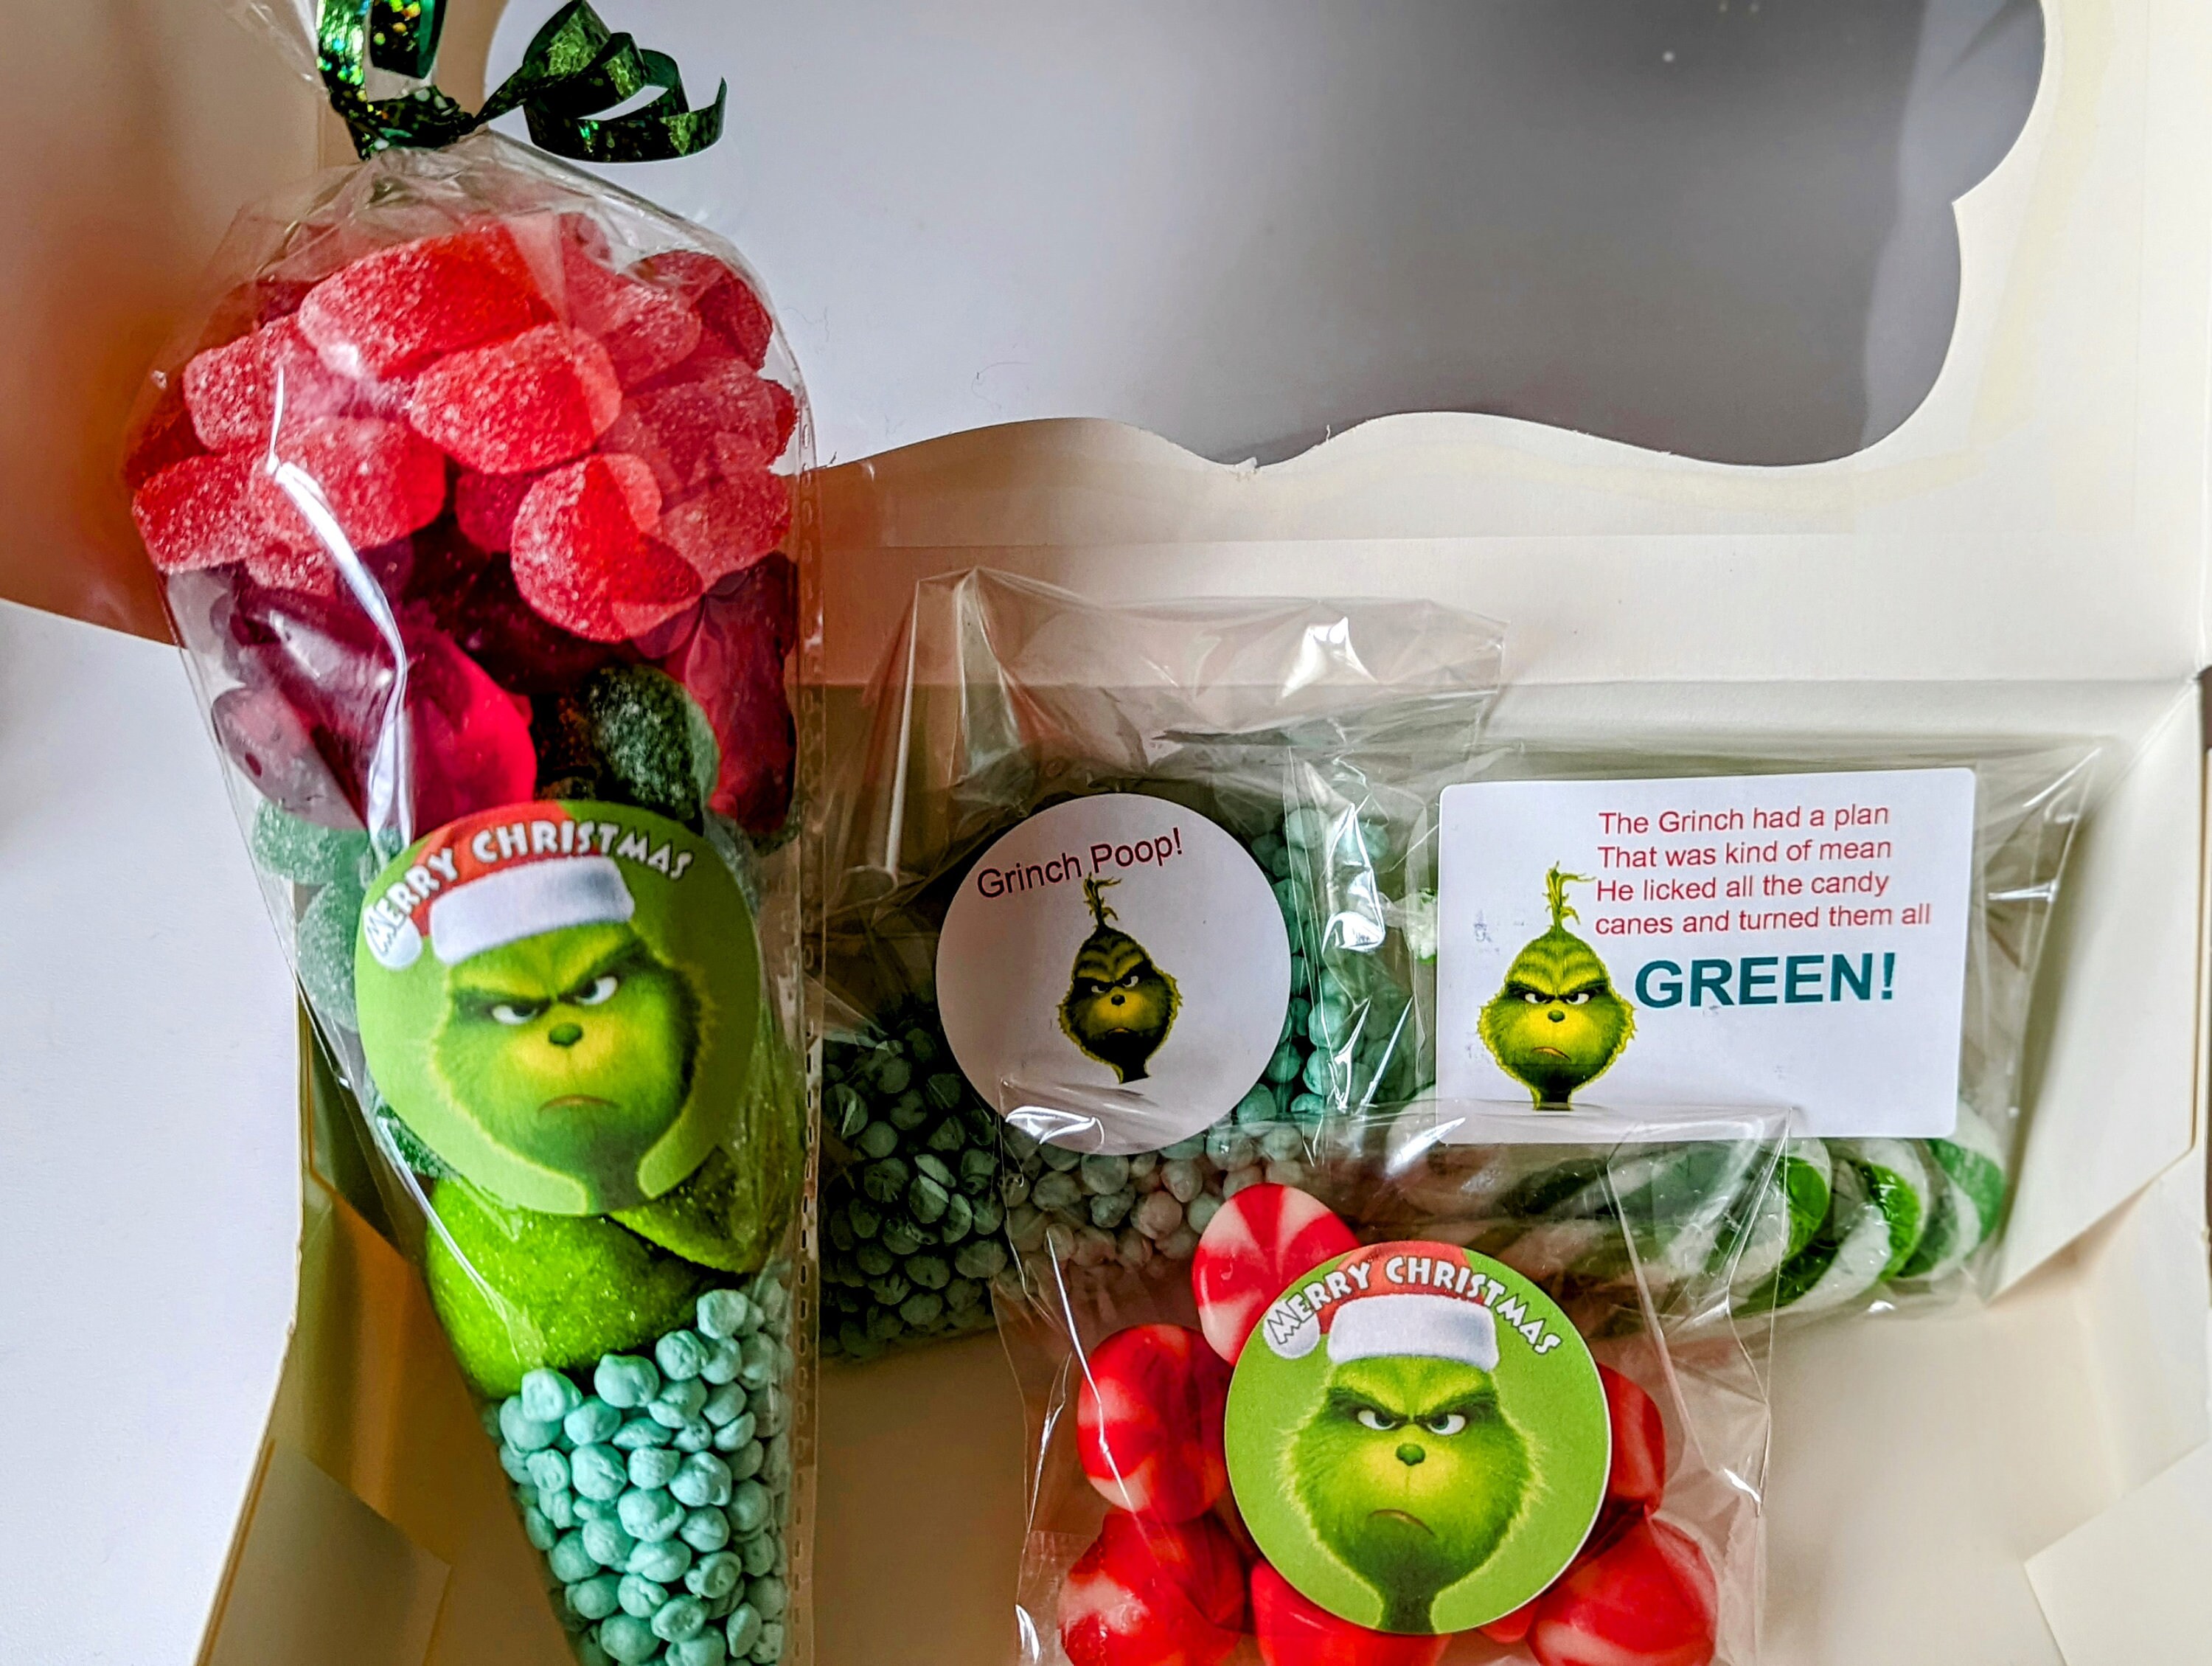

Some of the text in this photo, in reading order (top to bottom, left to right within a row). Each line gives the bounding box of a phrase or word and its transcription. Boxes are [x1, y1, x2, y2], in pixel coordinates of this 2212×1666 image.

[1599, 804, 1888, 834] The Grinch had a plan
[976, 827, 1183, 898] Grinch Poop!
[1597, 839, 1891, 868] That was kind of mean
[365, 819, 693, 954] MERRY CHRISTMAS
[1597, 872, 1889, 902] He licked all the candy
[1595, 903, 1930, 935] canes and turned them all
[1635, 952, 1896, 1009] GREEN!
[1266, 1256, 1562, 1356] MERRY CHRISTMAS
